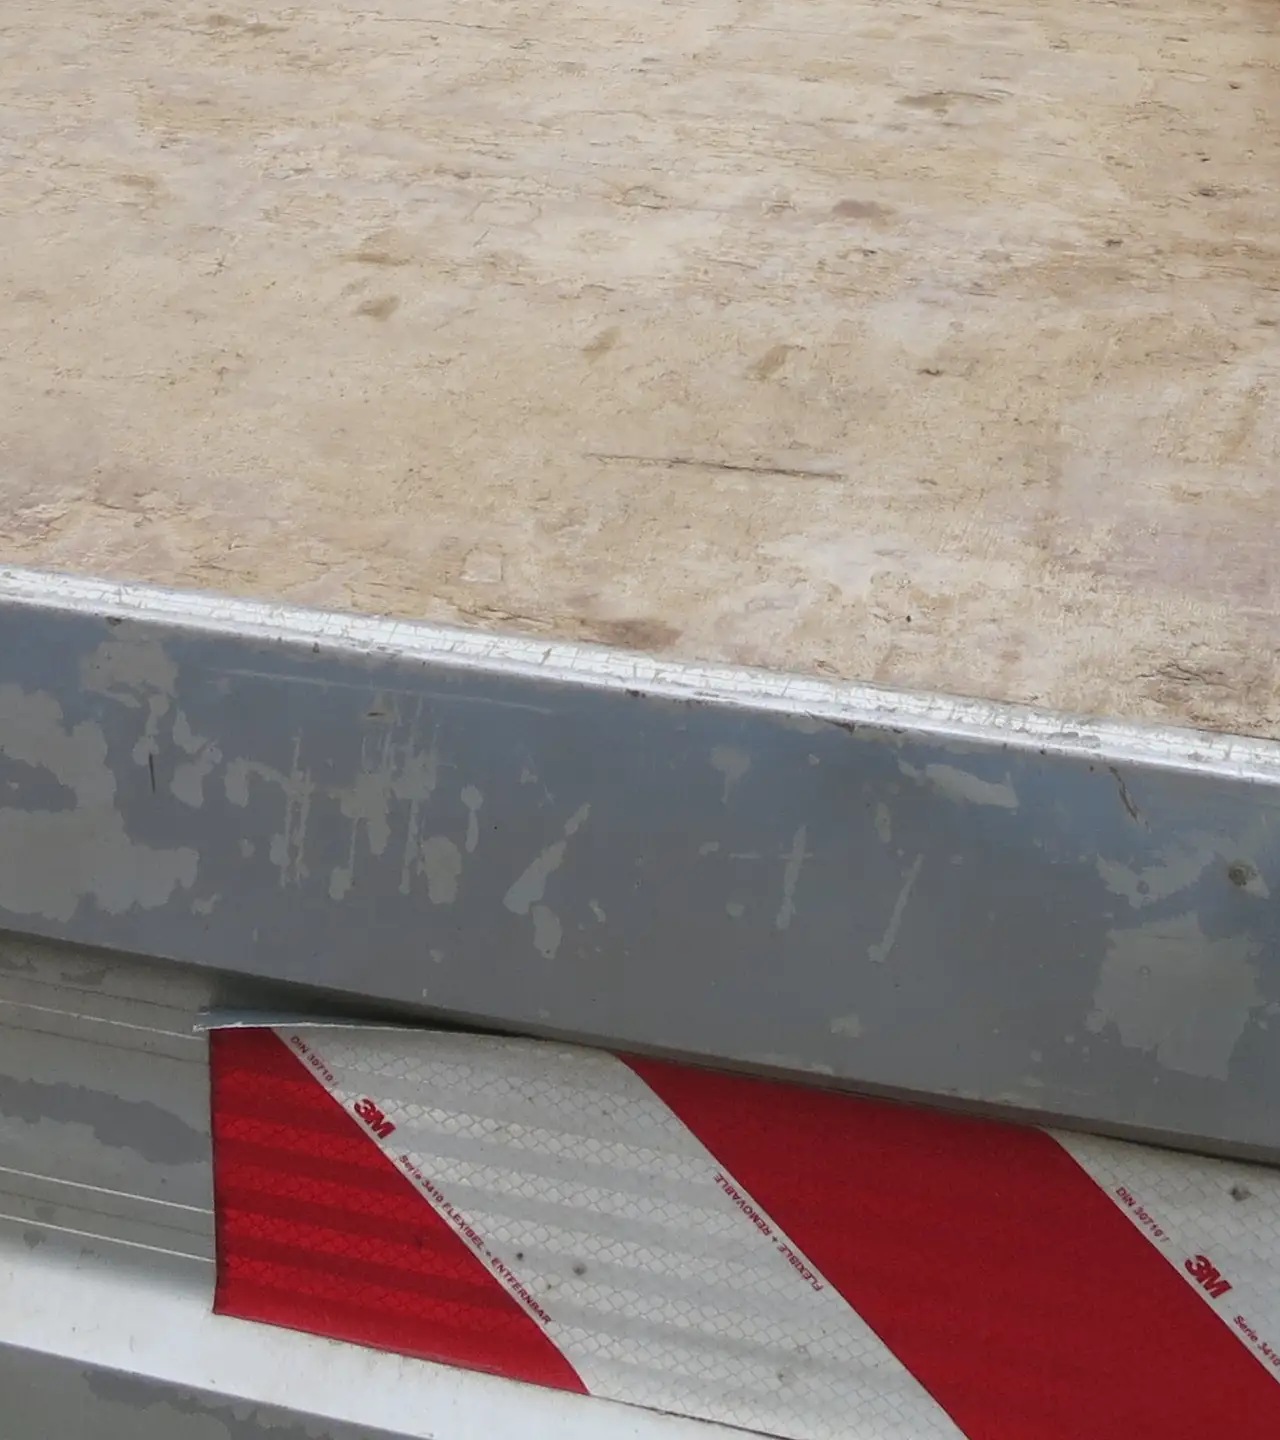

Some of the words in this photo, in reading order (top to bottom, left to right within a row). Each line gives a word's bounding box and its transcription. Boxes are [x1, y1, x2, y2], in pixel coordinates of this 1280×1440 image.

[290, 1035, 310, 1054] DIN
[353, 1098, 397, 1140] 3M
[713, 1171, 773, 1237] REMOVABLE
[1115, 1186, 1136, 1207] DIN
[399, 1154, 422, 1179] Serie
[421, 1178, 444, 1203] 3410
[442, 1201, 485, 1252] FLEXIBEL
[490, 1257, 552, 1325] ENTFERNBAR
[776, 1242, 824, 1292] FLEXIBLE
[1184, 1254, 1233, 1299] 3M
[1233, 1315, 1258, 1342] Serie
